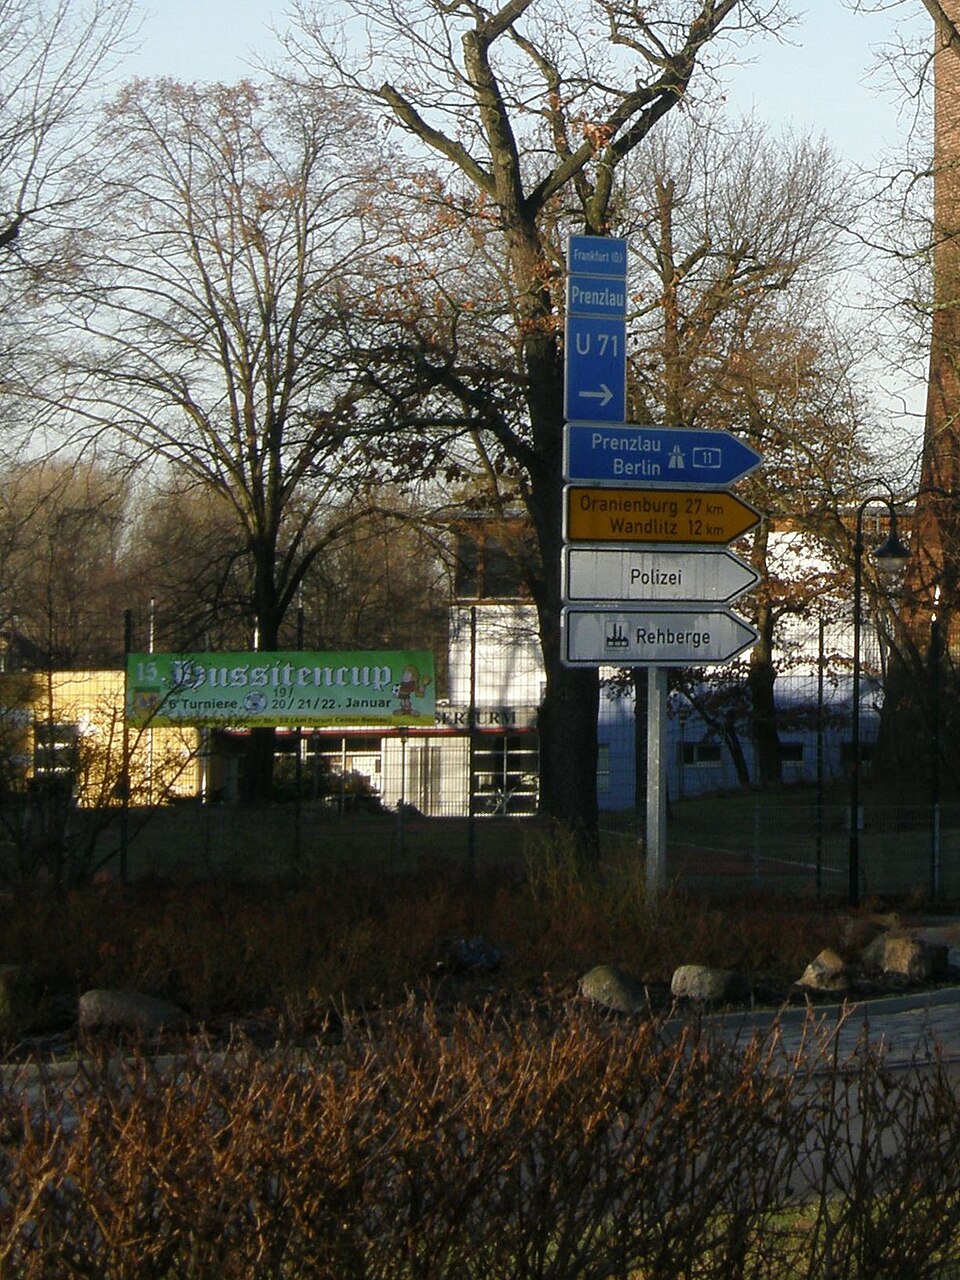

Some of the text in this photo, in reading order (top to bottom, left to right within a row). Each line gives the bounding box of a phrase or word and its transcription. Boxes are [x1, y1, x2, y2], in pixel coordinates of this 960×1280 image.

[574, 249, 610, 262] Frankfurt
[572, 286, 624, 306] Prenzlau
[575, 332, 618, 357] U 71
[592, 433, 661, 452] Prenzlau
[703, 451, 712, 464] 11
[613, 459, 661, 475] Berlin
[580, 495, 724, 517] Oranienburg 27 km
[610, 517, 724, 535] Wandlitz 12 km
[630, 569, 682, 586] Polizei
[636, 628, 711, 647] Rehberge
[346, 698, 392, 709] Januar
